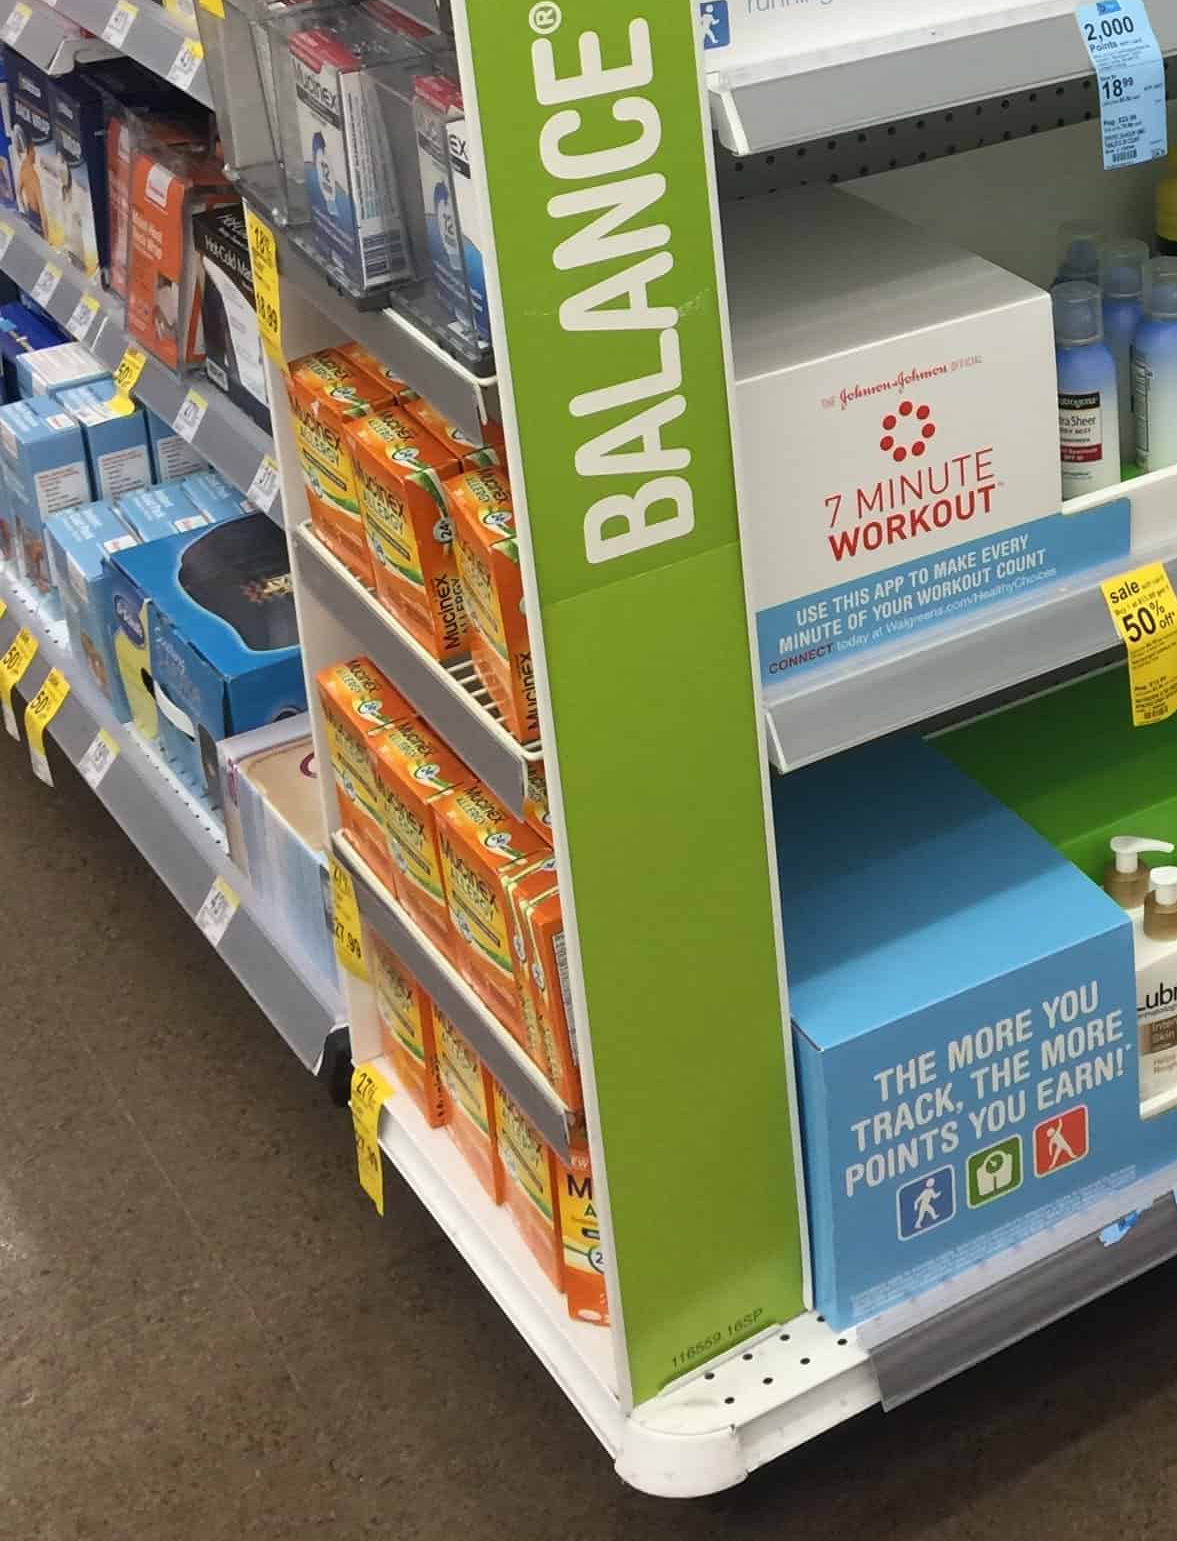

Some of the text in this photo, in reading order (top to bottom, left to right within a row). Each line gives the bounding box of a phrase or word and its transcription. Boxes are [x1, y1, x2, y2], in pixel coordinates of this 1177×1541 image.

[1084, 16, 1134, 42] 2,000
[824, 448, 996, 528] 7 MINUTE
[828, 485, 997, 562] WORKOUT
[435, 574, 461, 650] Mucinex
[778, 549, 1046, 656] MINUTE OF YOUR WORKOUT COUNT
[796, 534, 1031, 625] USE THIS APP TO MAKE EVERY
[1110, 579, 1140, 604] sale
[768, 643, 833, 675] CONNECT
[836, 630, 869, 654] today
[871, 624, 884, 640] at
[1122, 600, 1166, 643] 50%
[873, 981, 1098, 1102] THE MORE YOU
[851, 1010, 1123, 1152] TRACK, THE MORE
[845, 1123, 959, 1196] POINTS
[969, 1096, 1027, 1140] YOU
